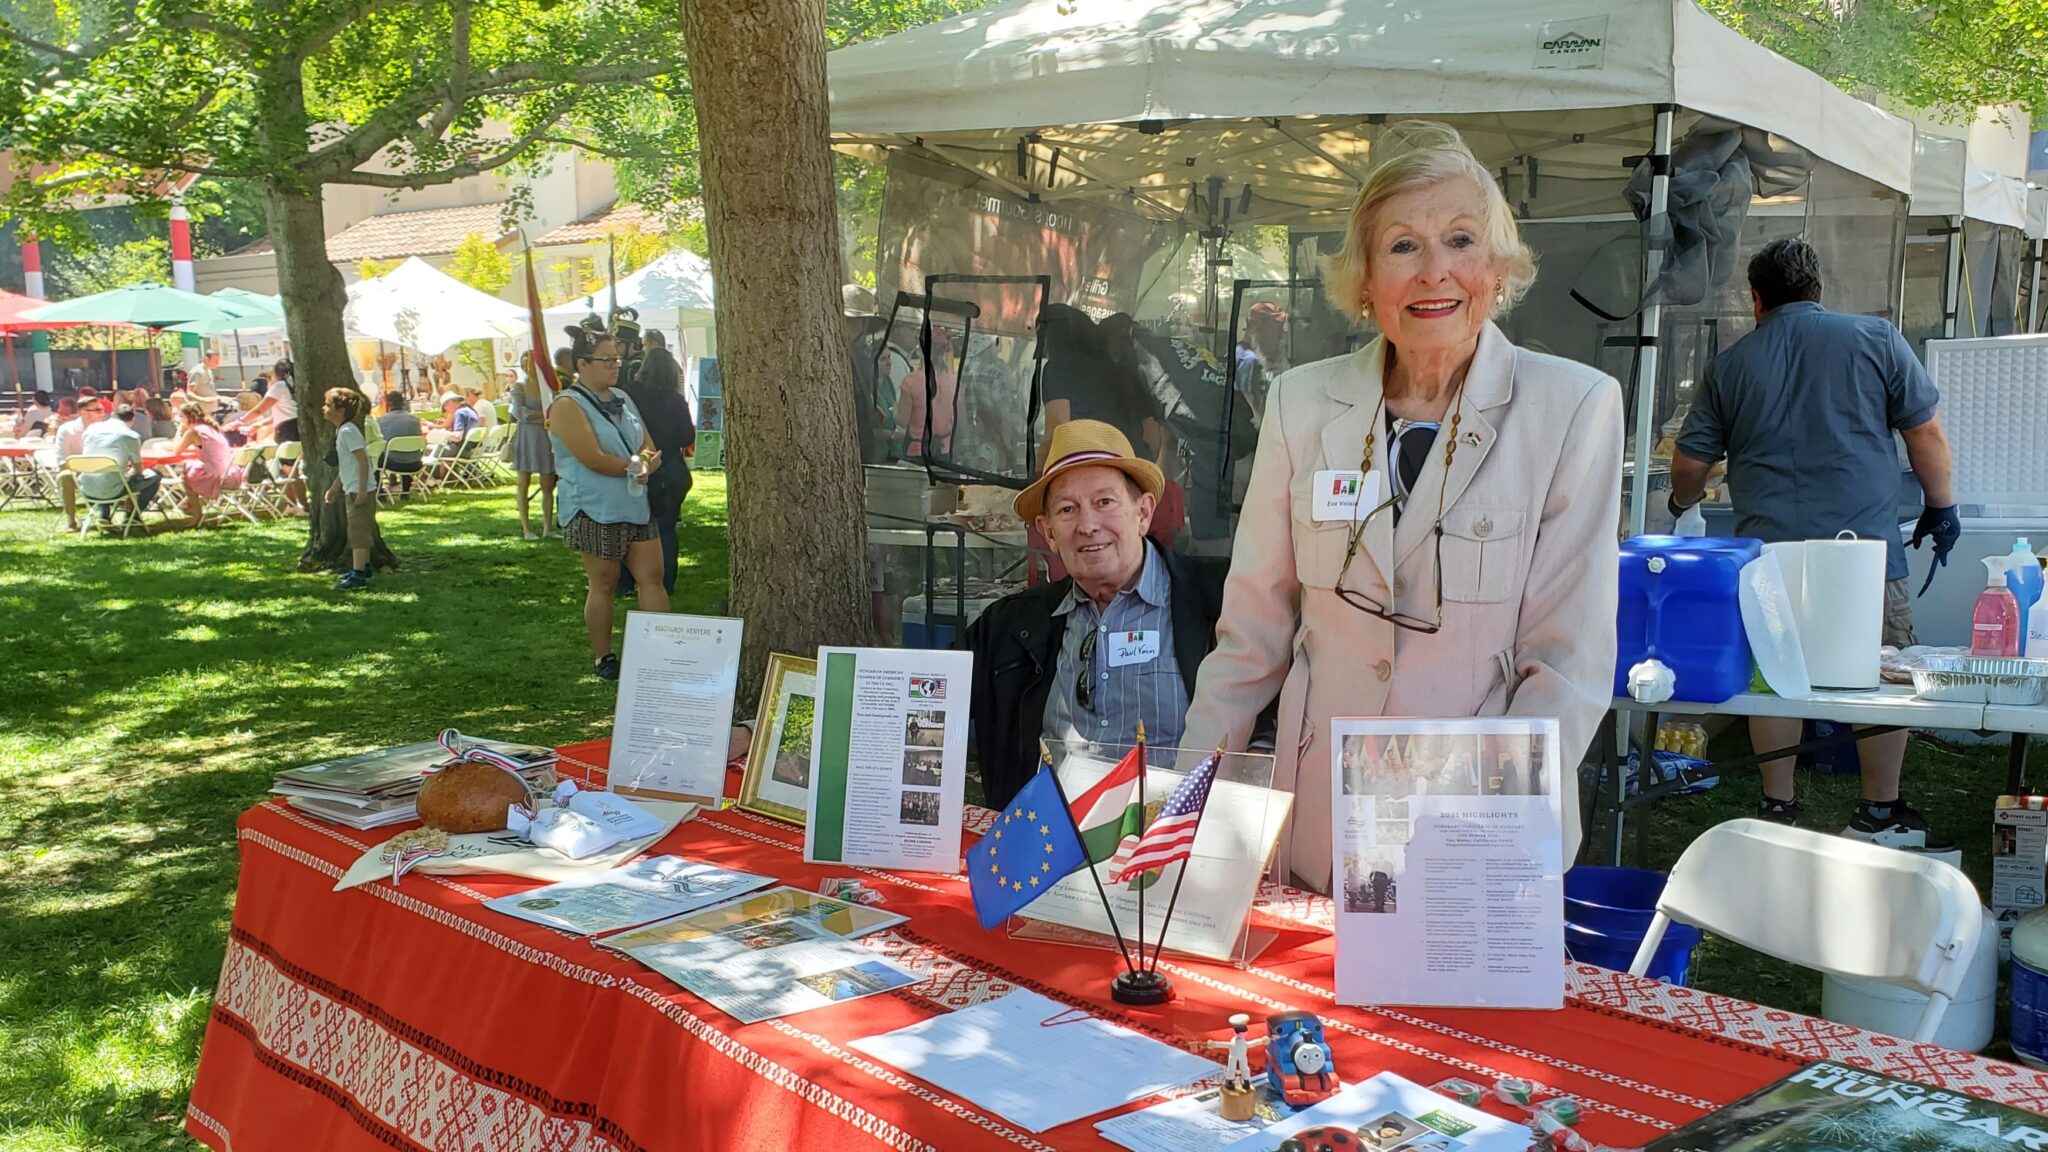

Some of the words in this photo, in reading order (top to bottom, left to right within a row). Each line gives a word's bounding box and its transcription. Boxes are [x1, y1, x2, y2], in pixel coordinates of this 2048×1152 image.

[1543, 38, 1601, 50] CARAVAN
[1462, 811, 1519, 819] HIGHLIGHTS
[1810, 1062, 1882, 1085] FREE
[1888, 1080, 1926, 1095] TO
[1929, 1090, 1971, 1108] BE
